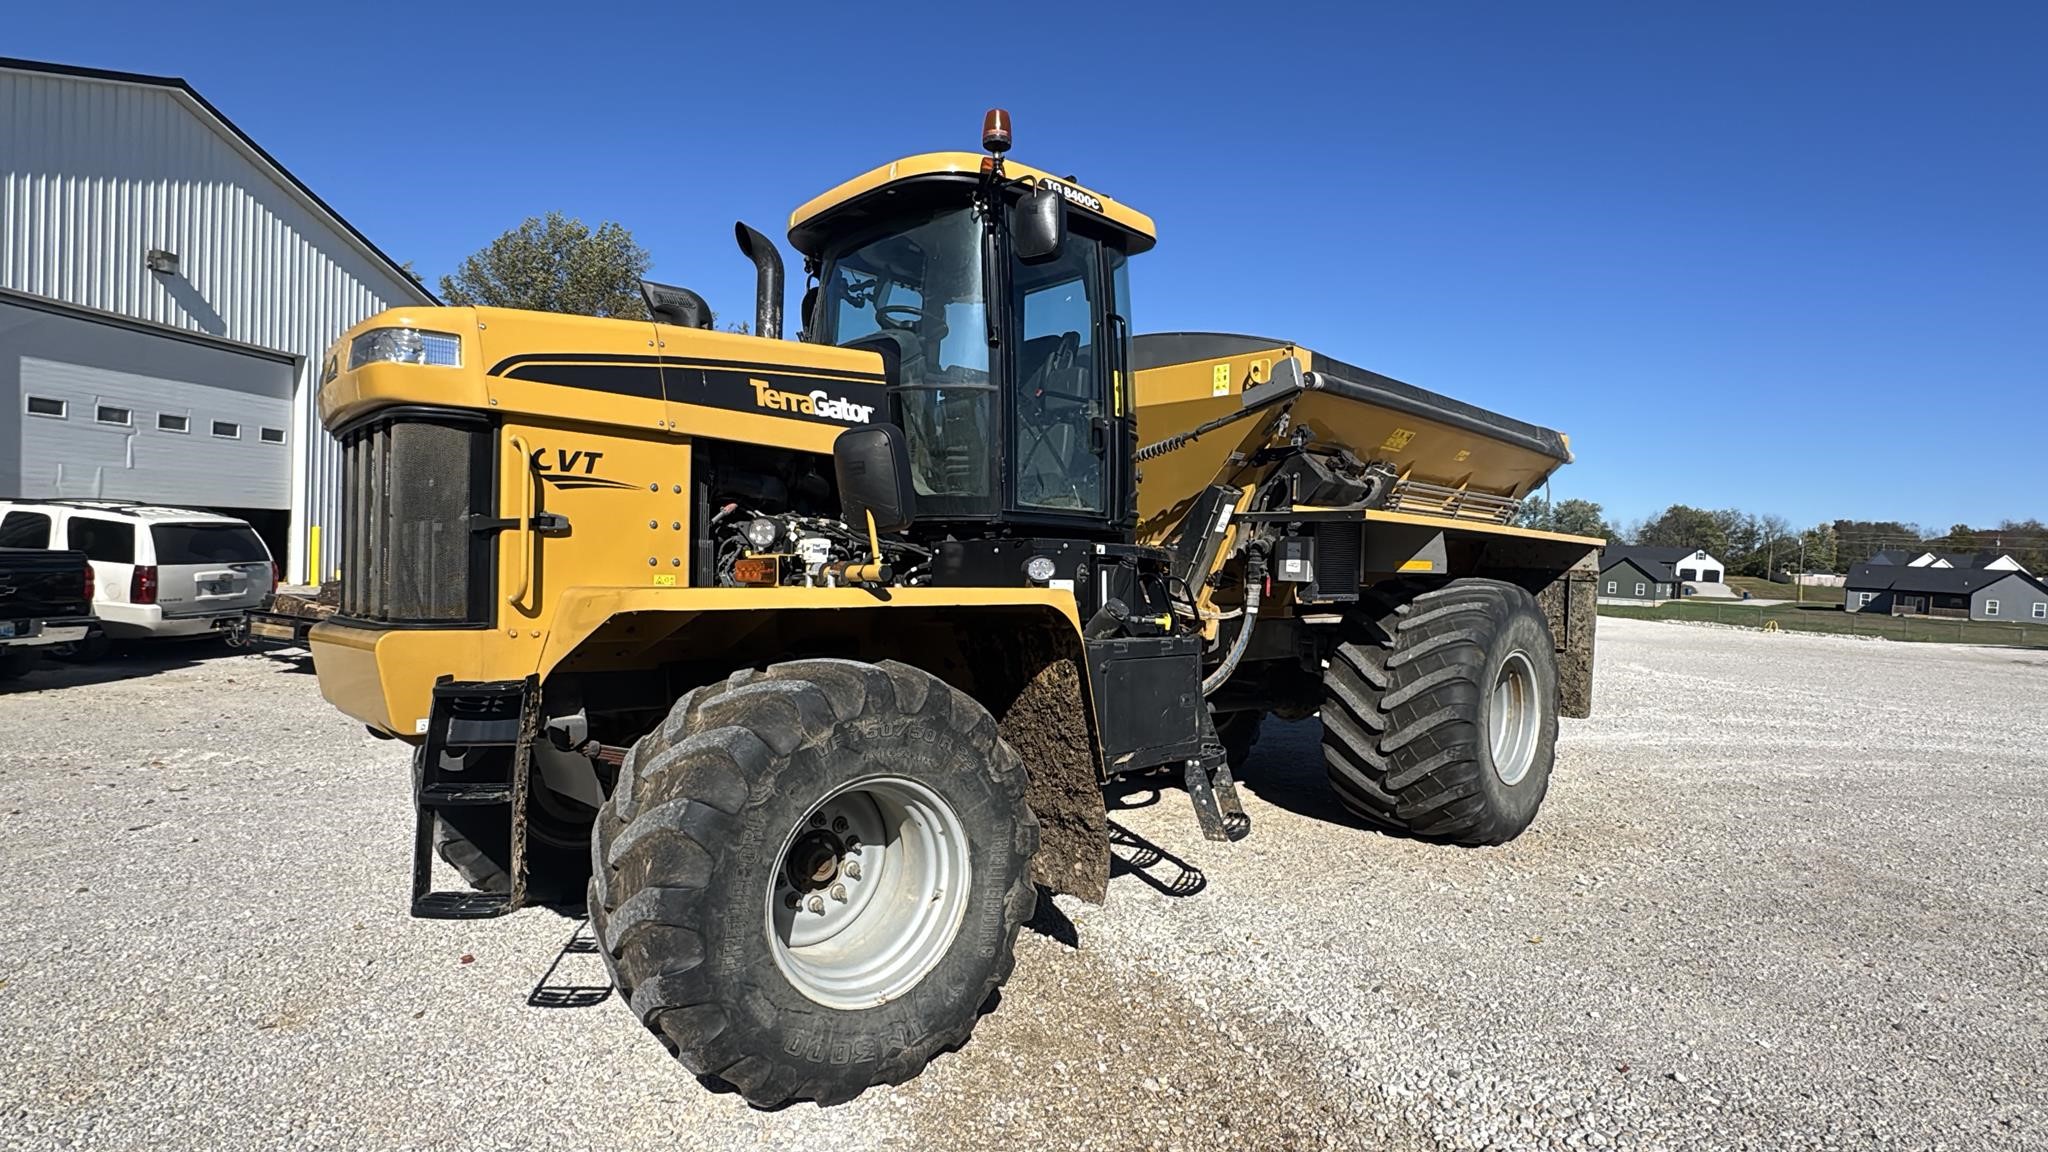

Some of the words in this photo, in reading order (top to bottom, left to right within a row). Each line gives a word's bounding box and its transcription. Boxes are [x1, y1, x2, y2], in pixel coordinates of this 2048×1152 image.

[1064, 186, 1100, 210] 8400C
[749, 378, 873, 424] TerraGator
[530, 447, 604, 474] CVT
